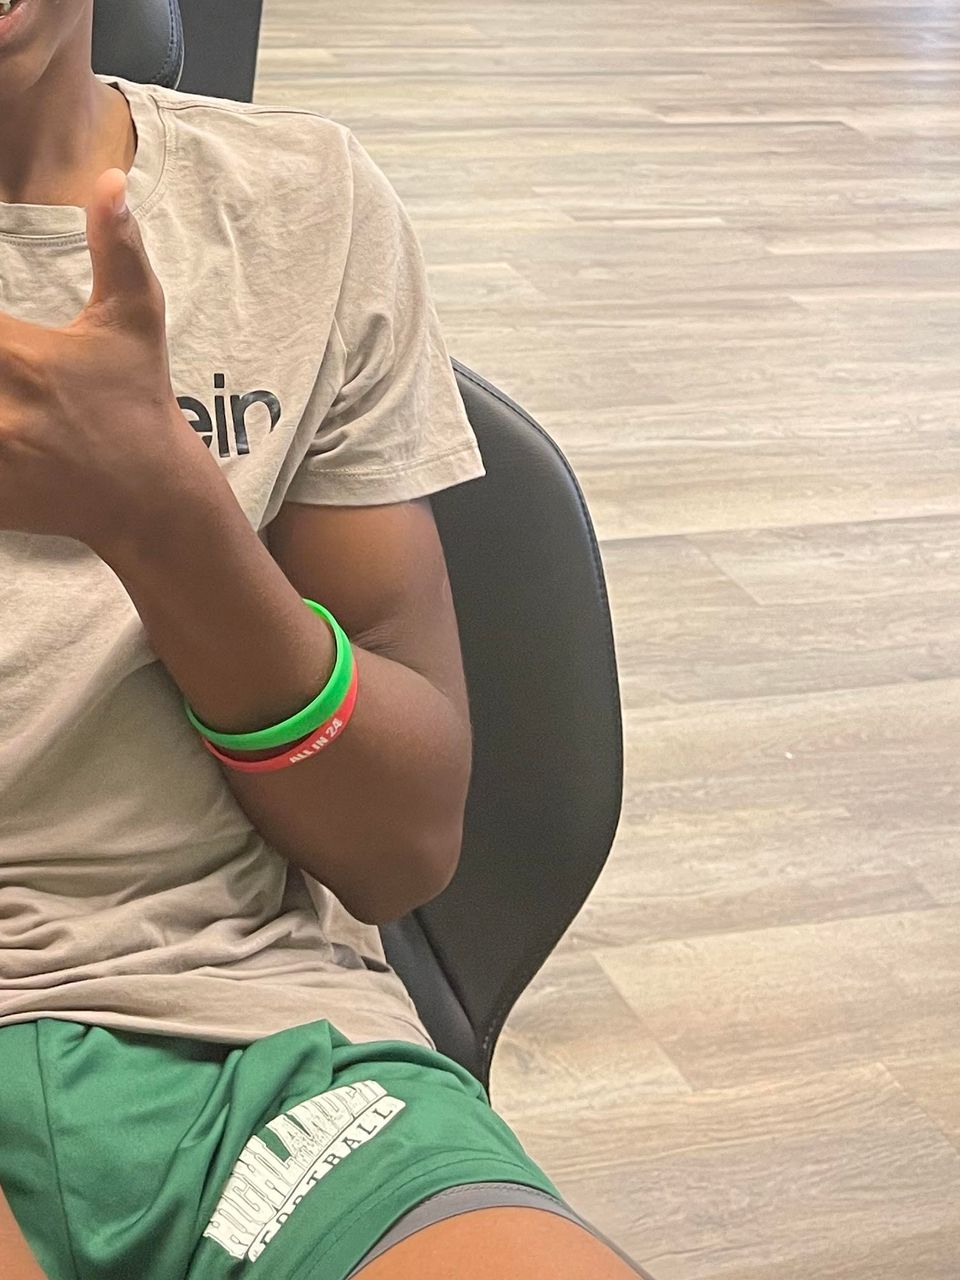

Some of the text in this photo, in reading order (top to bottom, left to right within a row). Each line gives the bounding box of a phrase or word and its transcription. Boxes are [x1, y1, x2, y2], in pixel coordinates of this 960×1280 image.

[175, 372, 282, 458] ein
[289, 749, 313, 763] ALL
[312, 736, 328, 750] IN
